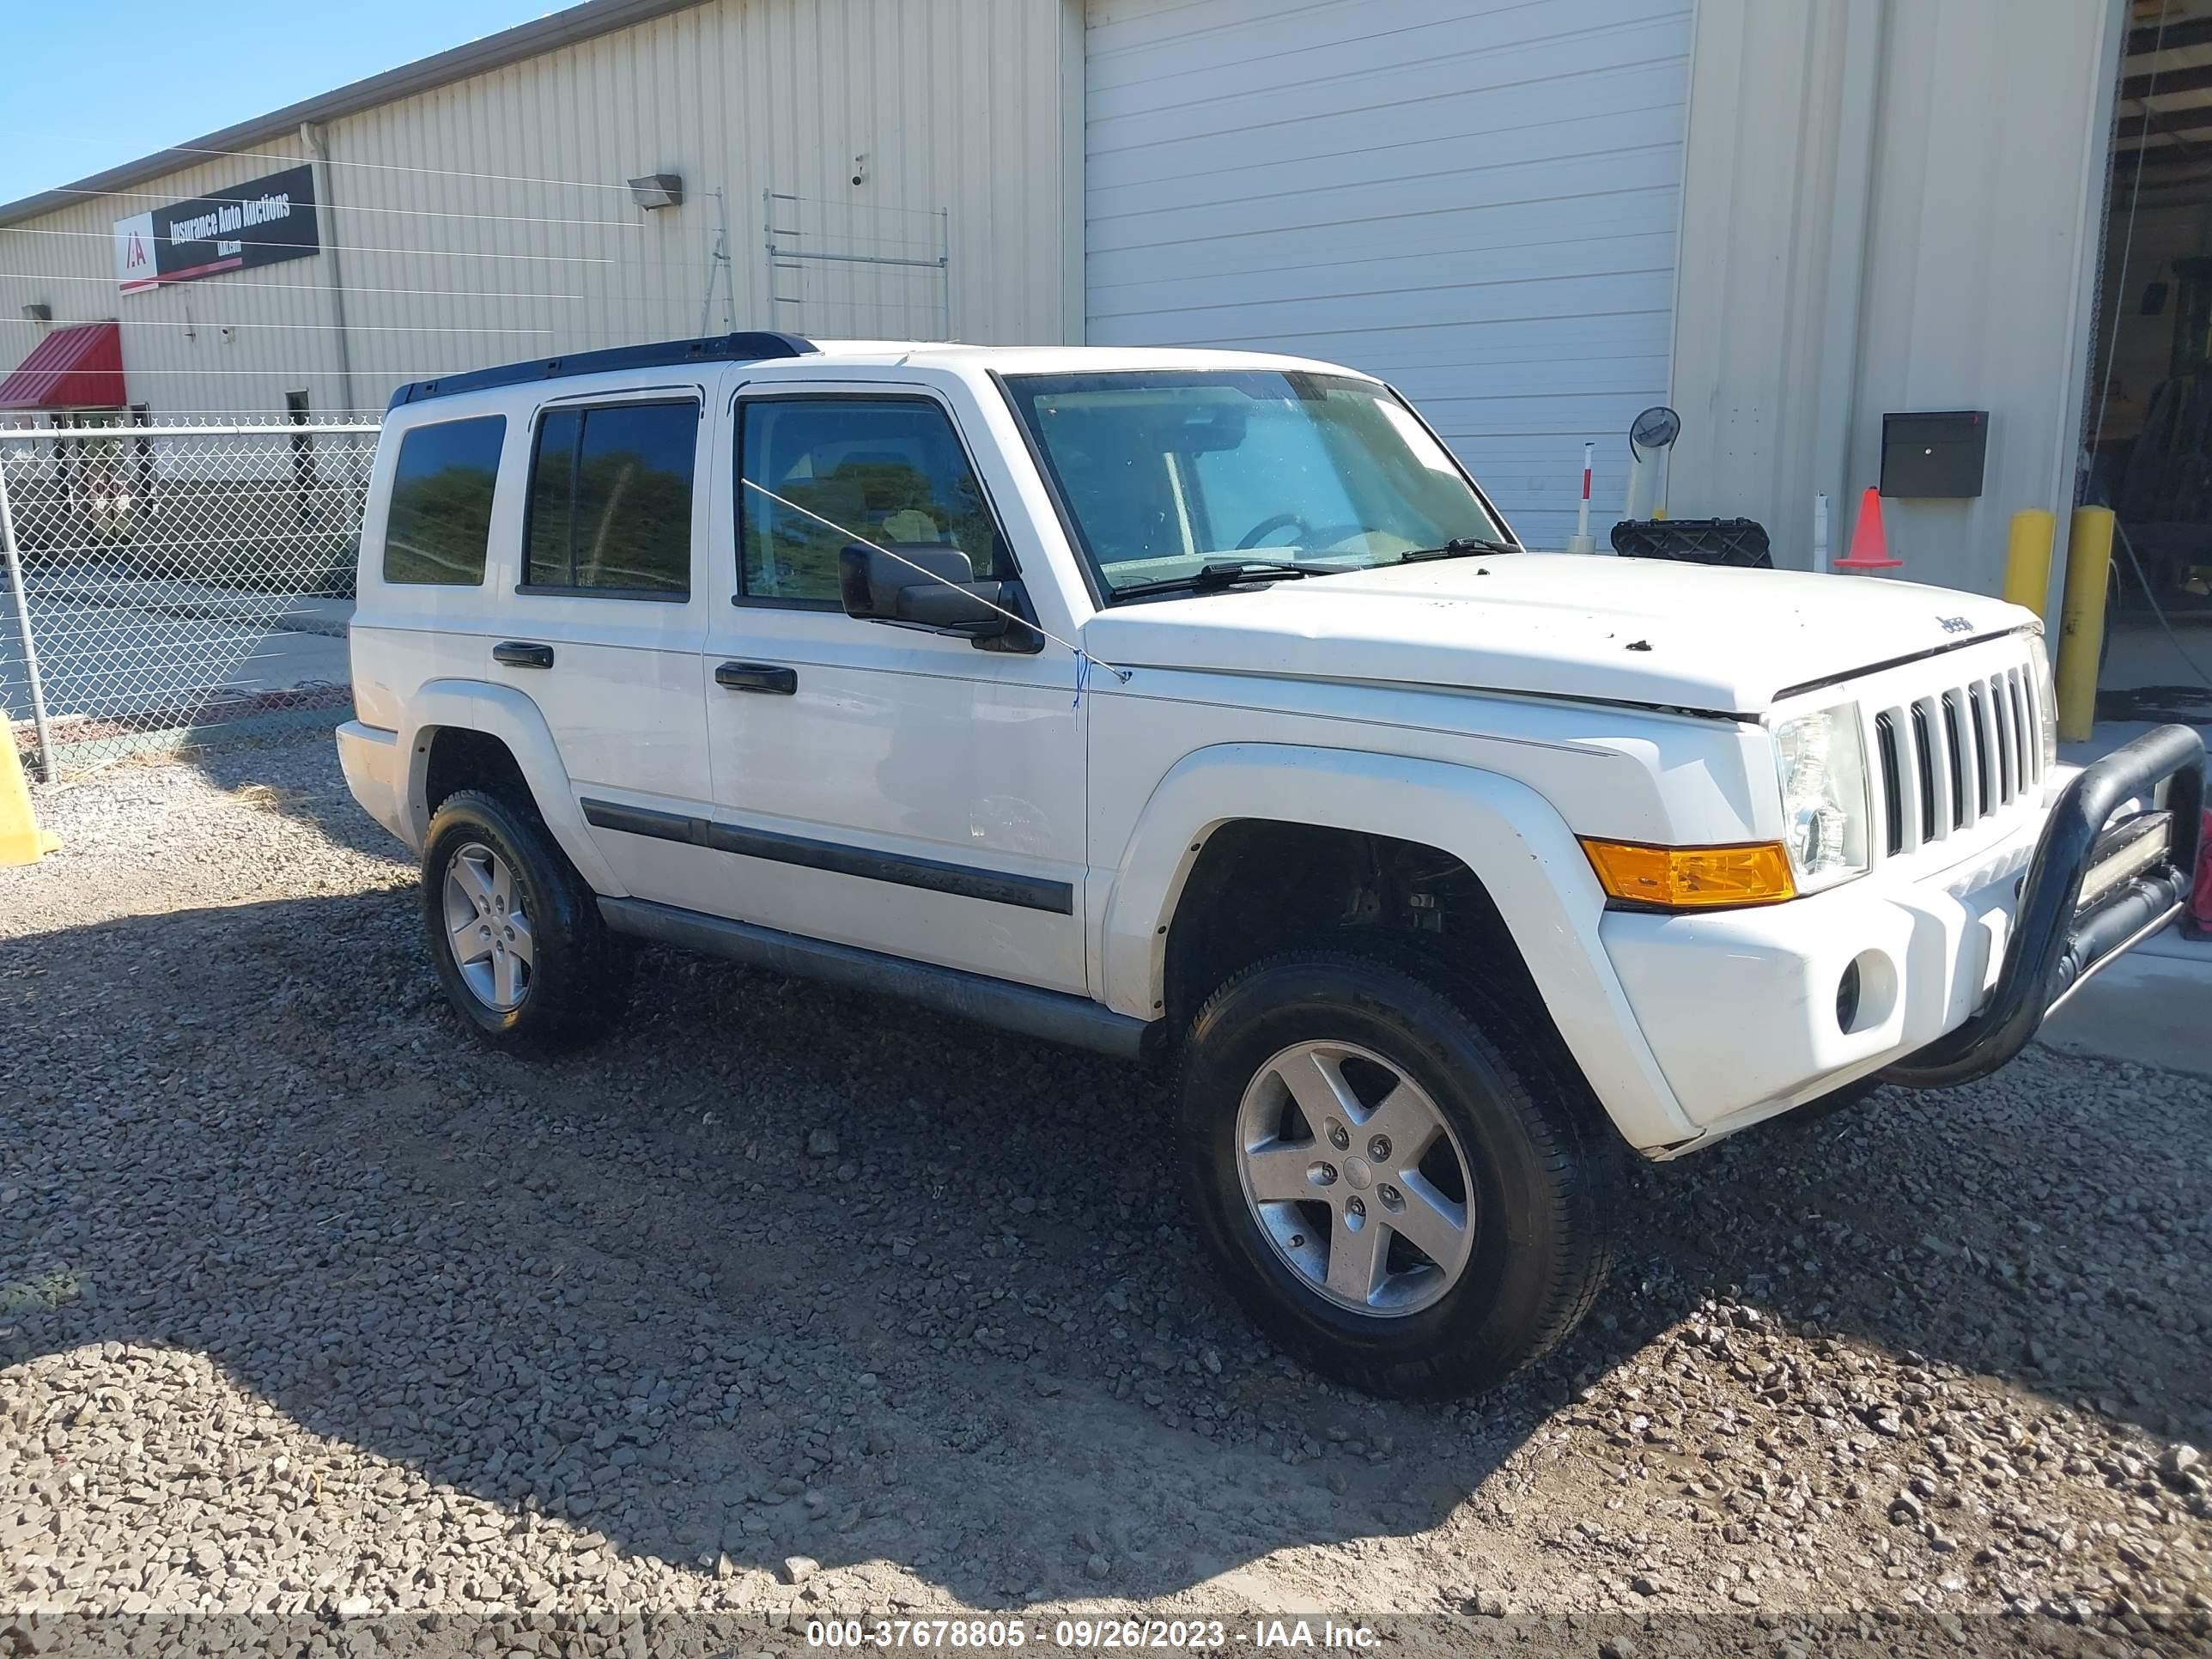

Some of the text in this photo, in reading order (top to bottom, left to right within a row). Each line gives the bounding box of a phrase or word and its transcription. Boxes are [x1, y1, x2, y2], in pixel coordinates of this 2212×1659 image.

[170, 192, 290, 246] Insurance Auto Auctions
